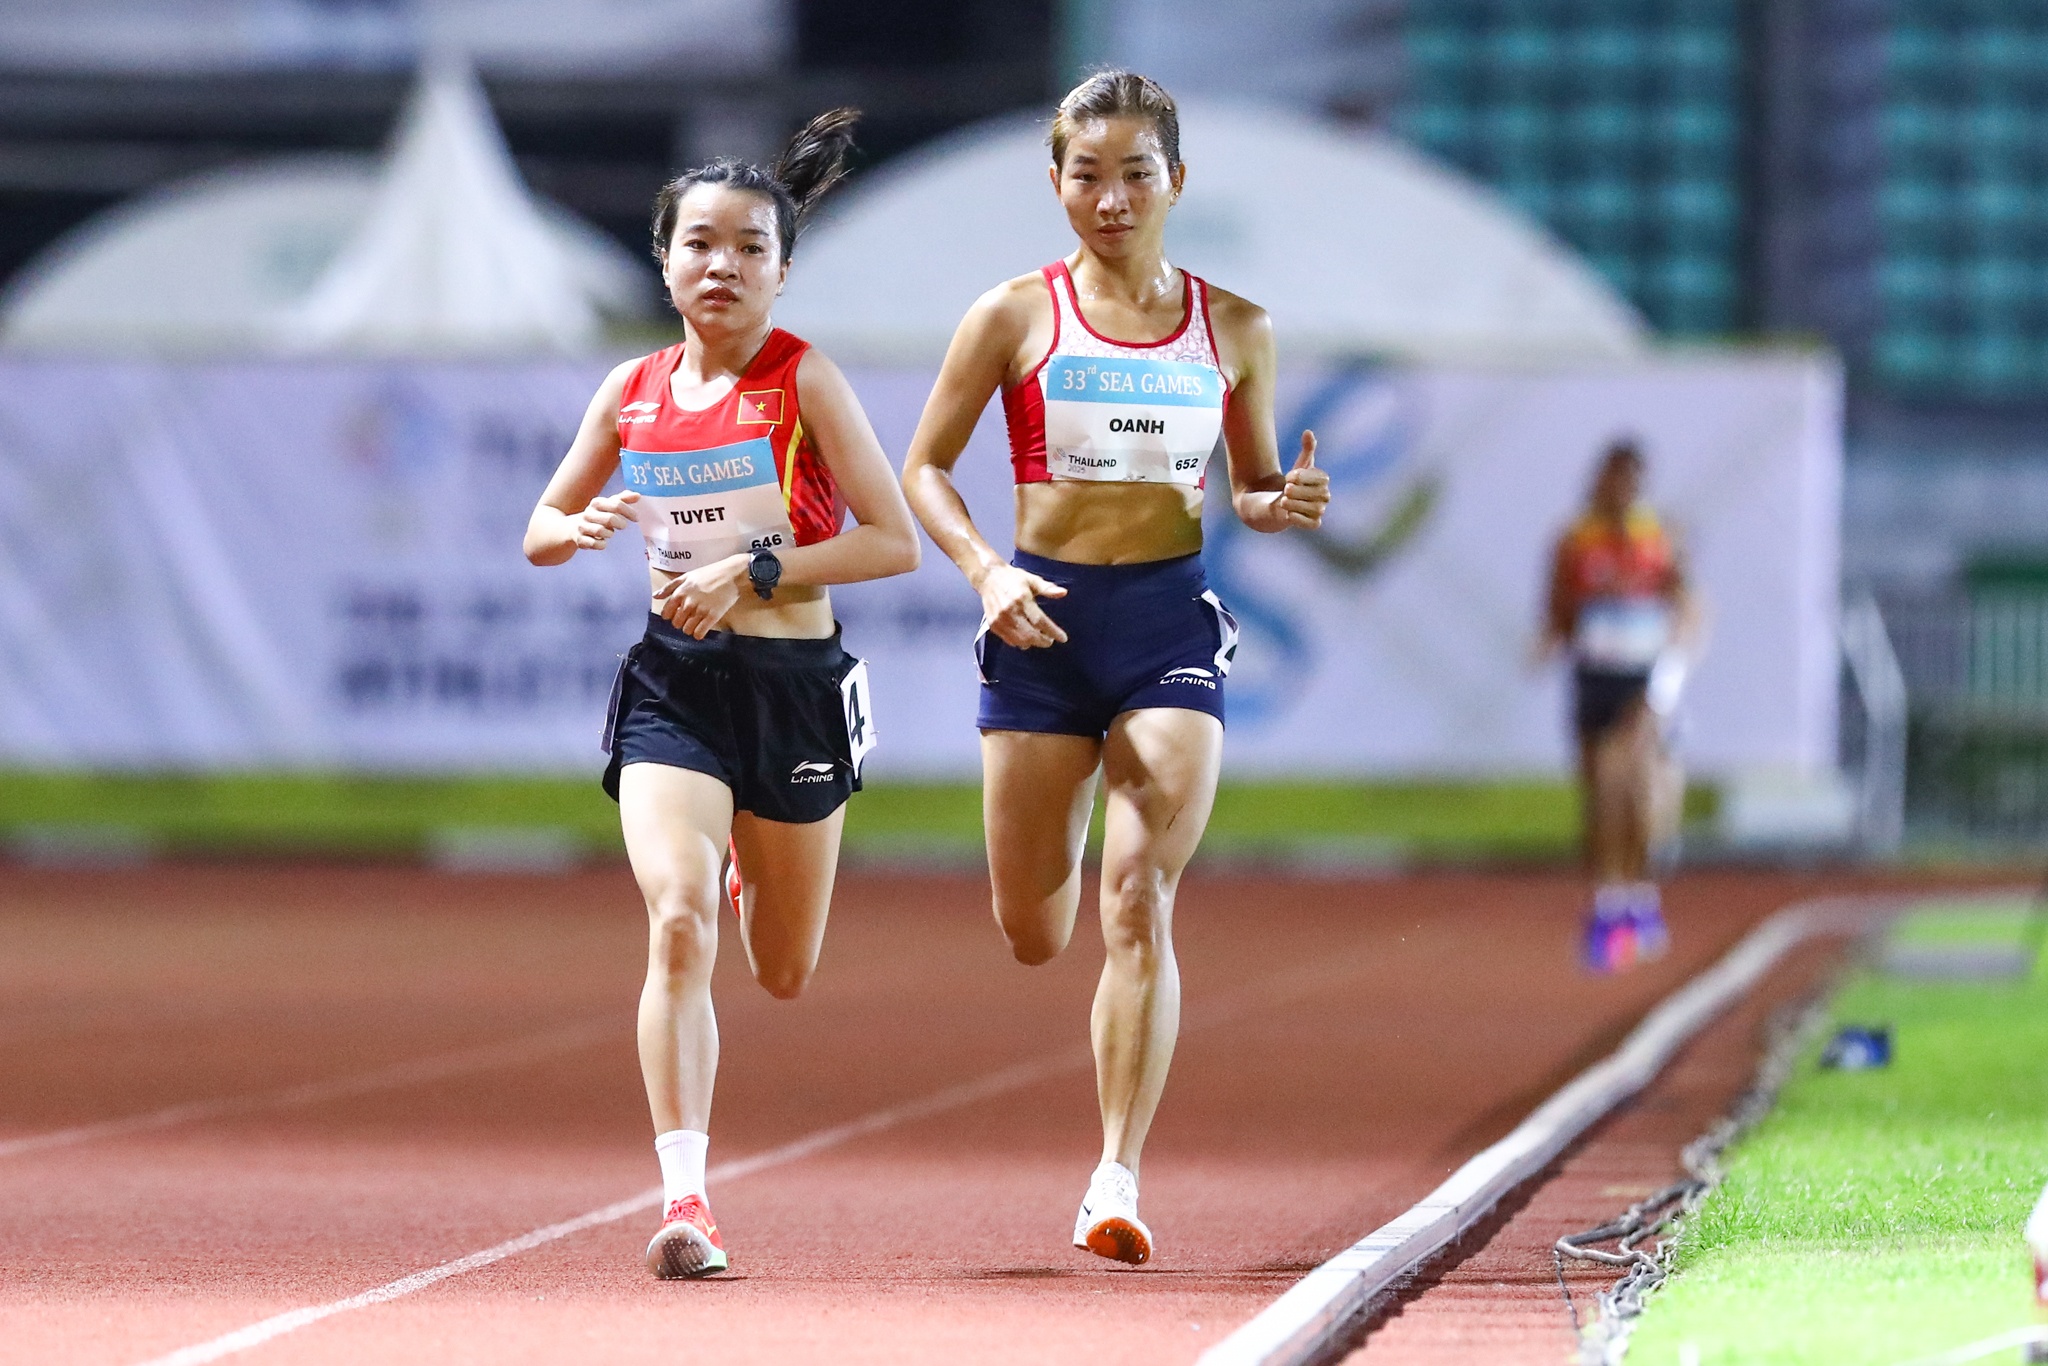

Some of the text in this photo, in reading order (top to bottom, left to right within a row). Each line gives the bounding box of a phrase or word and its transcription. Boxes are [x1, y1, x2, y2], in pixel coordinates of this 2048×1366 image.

[1099, 371, 1134, 393] SEA
[1141, 373, 1203, 396] GAMES
[1109, 418, 1165, 434] OANH
[1068, 454, 1117, 468] THAILAND
[1175, 457, 1199, 471] 652
[653, 465, 686, 486] SEA
[688, 454, 754, 484] GAMES
[670, 506, 726, 525] TUYET
[751, 533, 783, 549] 646
[1160, 677, 1216, 690] LI-NING
[848, 681, 865, 748] 4
[790, 773, 835, 783] LI-NING
